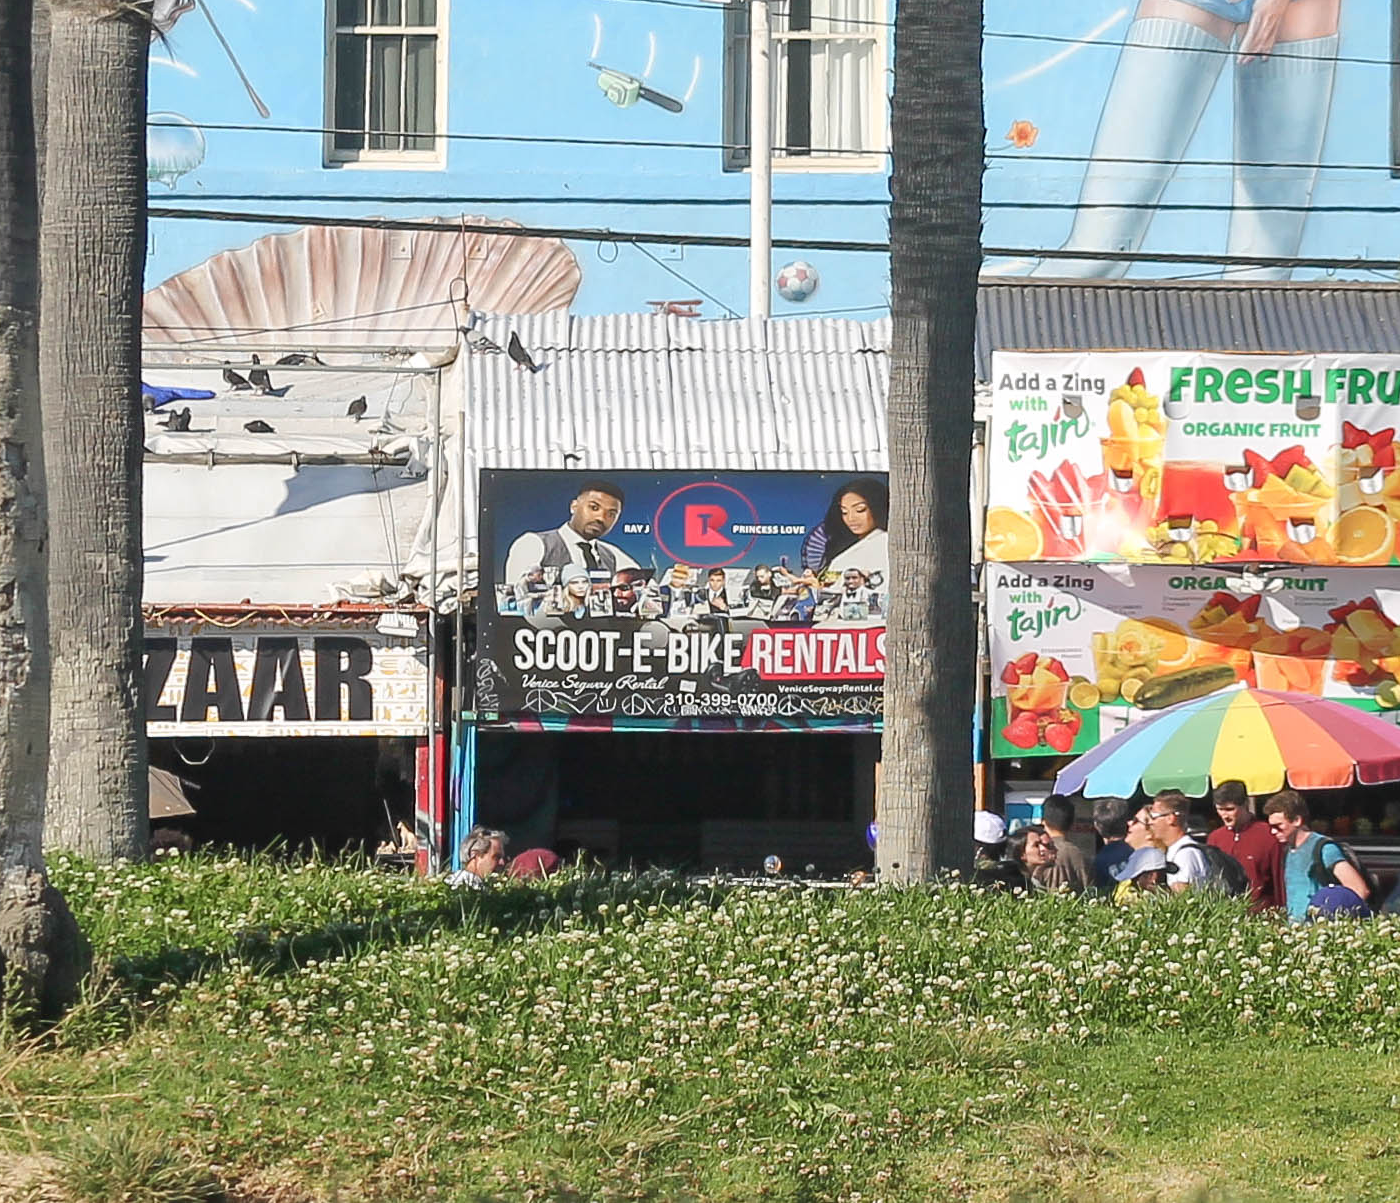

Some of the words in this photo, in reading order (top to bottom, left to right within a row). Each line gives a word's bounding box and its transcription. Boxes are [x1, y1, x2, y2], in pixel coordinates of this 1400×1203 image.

[999, 373, 1040, 391] Add
[1046, 377, 1057, 391] a
[1062, 372, 1105, 396] Zing
[1009, 396, 1048, 411] with
[1183, 423, 1265, 437] ORGANIC
[1269, 423, 1321, 437] FRUIT
[624, 524, 643, 534] RAY
[732, 524, 778, 535] PRINCESS
[780, 525, 805, 535] LOVE
[997, 574, 1033, 588] Add
[1037, 577, 1049, 588] a
[1053, 574, 1095, 591] Zing
[1168, 576, 1226, 591] ORGA
[1283, 577, 1328, 591] RUIT
[1009, 591, 1042, 603] with
[514, 629, 744, 674] SCOOT-E-BIKE
[143, 636, 374, 722] ZAAR
[521, 674, 561, 689] Venice
[561, 674, 614, 695] Segway
[616, 676, 669, 690] Rental
[664, 692, 778, 708] 310-399-0700
